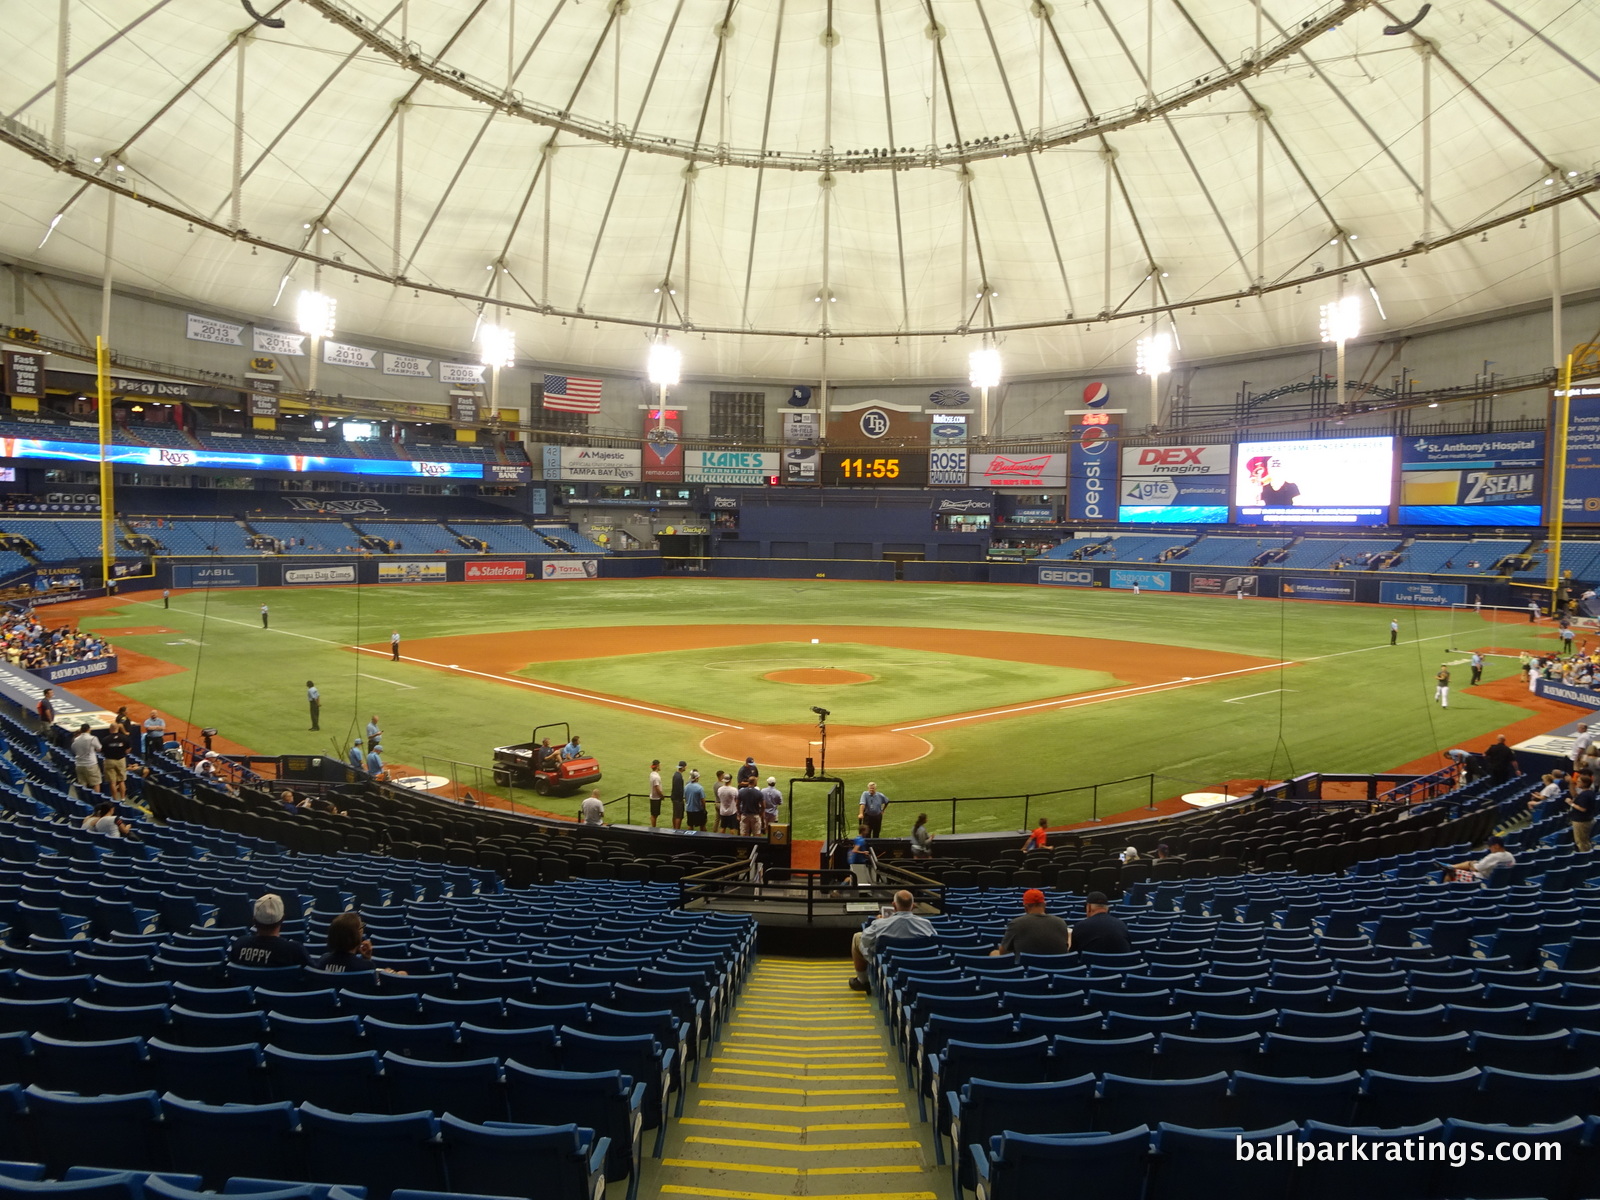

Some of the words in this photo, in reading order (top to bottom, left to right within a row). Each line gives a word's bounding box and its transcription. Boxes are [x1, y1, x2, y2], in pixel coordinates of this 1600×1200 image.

[189, 317, 218, 327] AMERICAN
[219, 323, 240, 332] LEAGUE
[201, 325, 229, 338] 2013
[193, 331, 212, 340] WILD
[214, 335, 235, 344] CARD
[266, 338, 291, 347] 2011
[258, 343, 276, 352] WILD
[14, 355, 35, 365] Fast
[336, 350, 363, 360] 2010
[327, 356, 370, 367] CHAMPIONS
[393, 361, 419, 370] 2008
[12, 364, 39, 373] news
[386, 367, 426, 376] CHAMPIONS
[450, 368, 474, 377] 2008
[16, 371, 36, 380] you
[17, 378, 36, 387] can
[16, 386, 37, 394] use.
[118, 380, 155, 395] Party
[158, 383, 189, 396] Deck
[257, 401, 272, 409] the
[252, 408, 277, 416] buzz?
[865, 414, 886, 433] TB
[1428, 443, 1442, 453] St.
[1442, 441, 1491, 453] Anthony's
[1491, 440, 1536, 452] Hospital
[546, 447, 558, 457] 42
[591, 451, 625, 460] Majestic
[1138, 447, 1207, 466] DEX
[547, 458, 556, 467] 12
[702, 451, 763, 468] KANE'S
[930, 452, 966, 470] ROSE
[492, 466, 524, 474] REPUBLIC
[840, 458, 900, 479] 11:55
[990, 461, 1044, 472] Budweiser
[1152, 464, 1211, 474] imaging
[546, 469, 558, 479] 66
[568, 467, 597, 476] TAMPA
[597, 468, 613, 477] BAY
[645, 469, 681, 477] remax.com
[930, 470, 966, 484] RADIOLOGY
[1083, 459, 1104, 518] pepsi
[1143, 481, 1169, 497] gte
[1180, 487, 1227, 495] gtefinancial.org
[970, 501, 991, 509] PORCH
[682, 526, 707, 535] Ducky's
[48, 567, 81, 575] LANDING
[197, 568, 235, 577] JABIL
[289, 569, 315, 581] Tampa
[314, 570, 329, 582] Bay
[329, 570, 352, 580] Times
[1040, 569, 1092, 584] GEICO
[1115, 570, 1150, 584] Sagicor
[1192, 577, 1222, 587] GMC
[1395, 593, 1413, 601] Live
[1413, 593, 1448, 604] Fiercely.
[50, 665, 87, 680] RAYMOND
[85, 661, 108, 673] JAMES
[1543, 684, 1579, 701] RAYMOND
[1577, 692, 1600, 706] JAMES
[239, 946, 272, 965] POPPY
